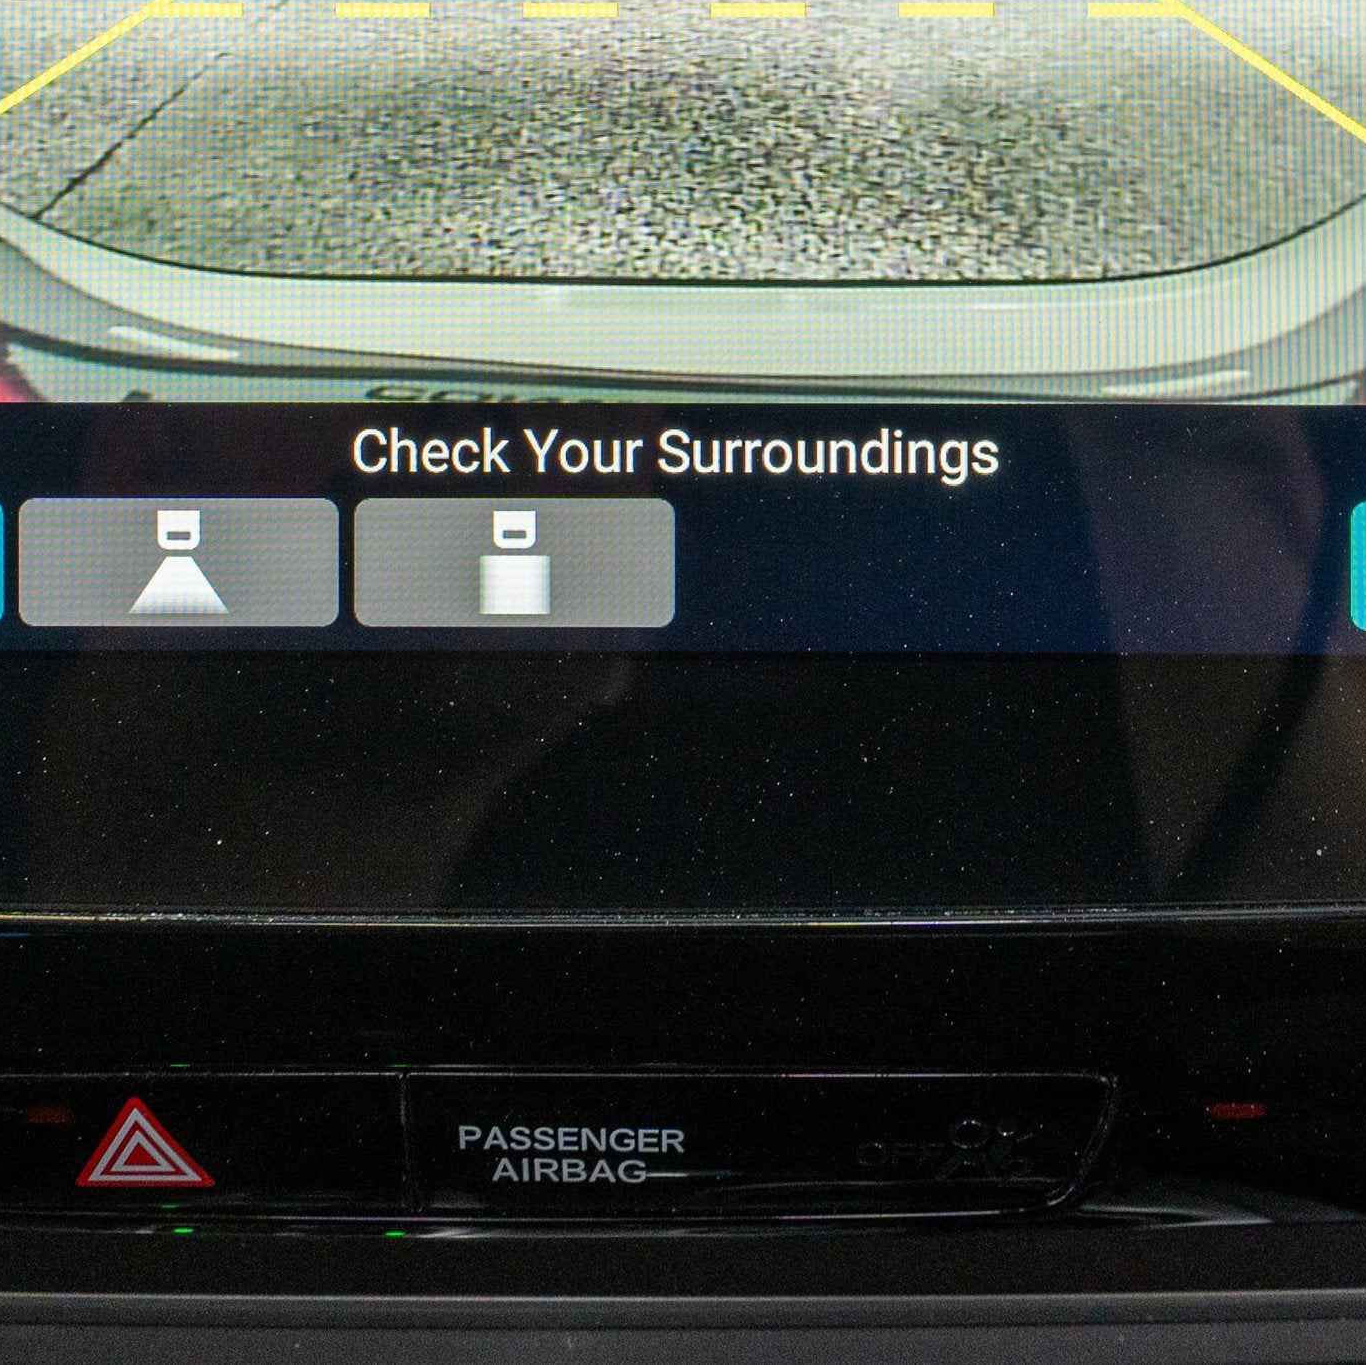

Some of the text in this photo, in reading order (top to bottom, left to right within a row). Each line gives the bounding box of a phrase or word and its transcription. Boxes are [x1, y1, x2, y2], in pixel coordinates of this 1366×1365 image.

[353, 428, 999, 485] Check Your Surroundings
[458, 1125, 685, 1153] PASSENGER
[492, 1158, 647, 1183] AIRBAG
